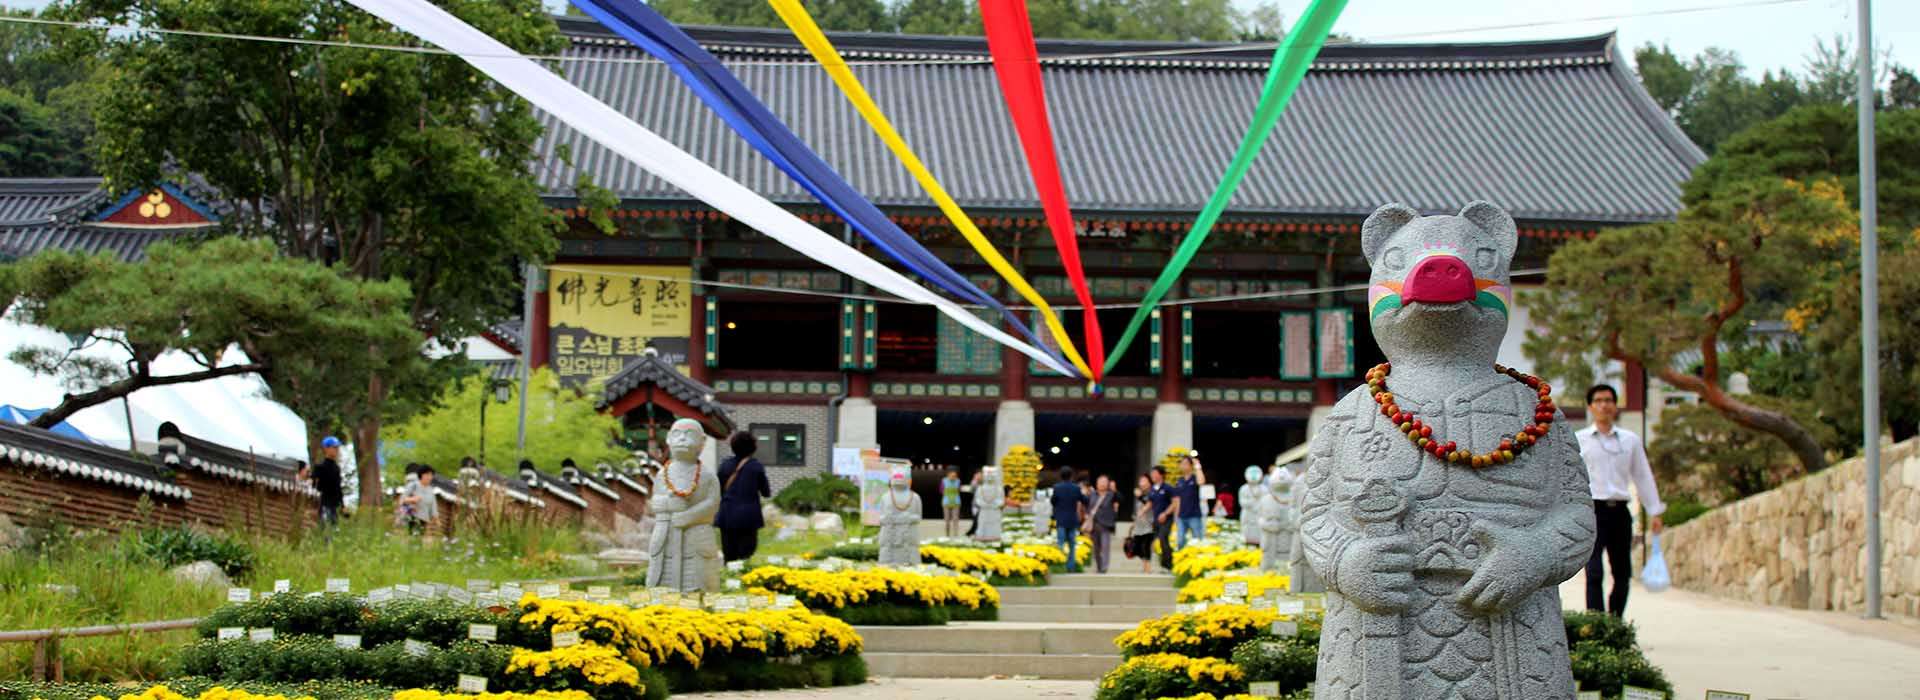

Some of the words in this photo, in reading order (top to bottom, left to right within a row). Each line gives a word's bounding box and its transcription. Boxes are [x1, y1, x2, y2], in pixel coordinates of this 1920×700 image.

[557, 273, 687, 316] 佛光普照
[557, 335, 575, 355] 큰
[579, 336, 613, 356] 스님
[557, 356, 624, 377] 일요법회
